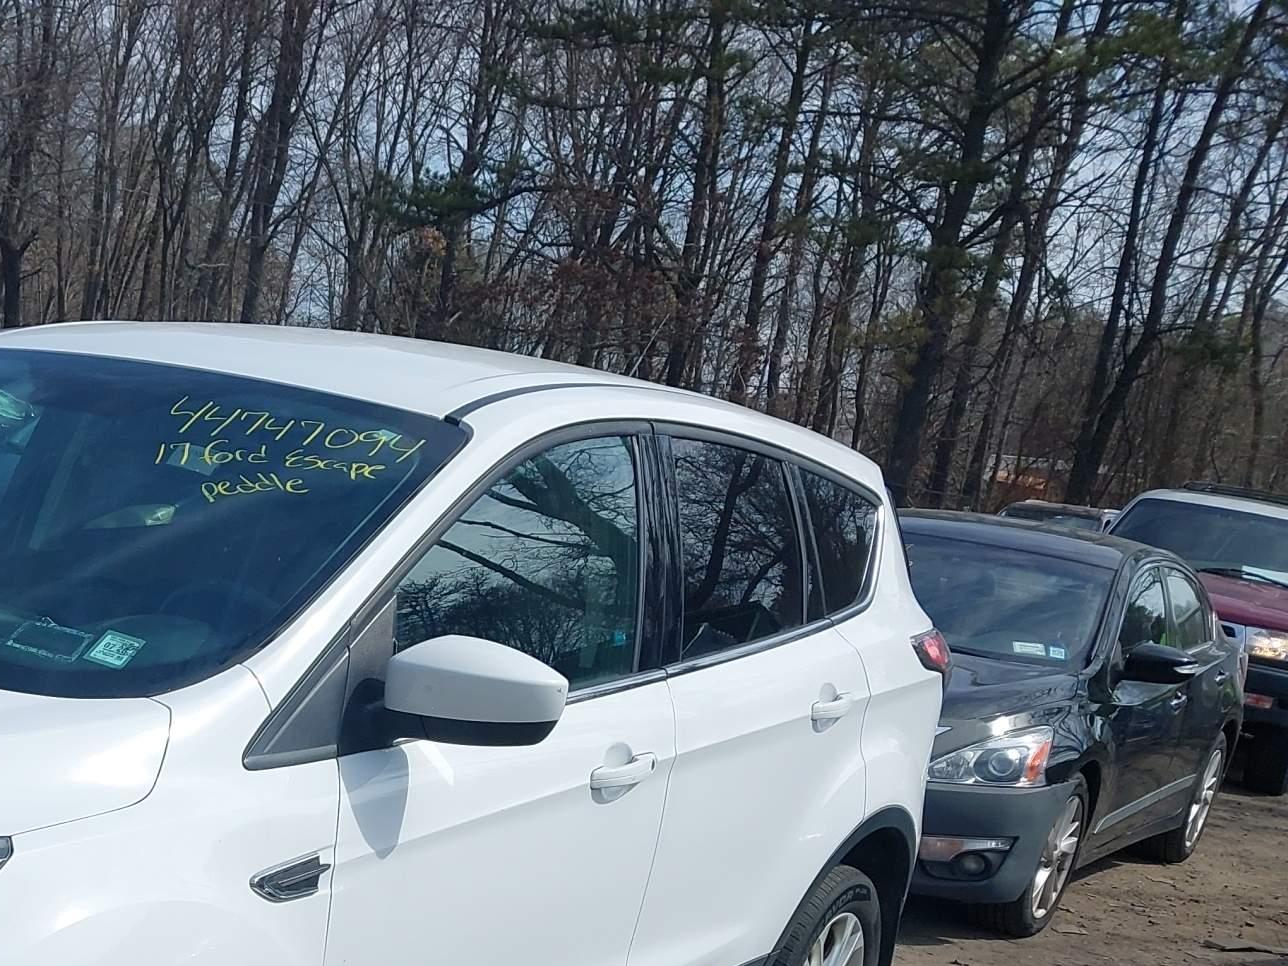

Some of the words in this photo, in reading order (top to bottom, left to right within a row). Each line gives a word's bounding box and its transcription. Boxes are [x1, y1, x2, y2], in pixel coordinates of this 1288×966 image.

[170, 395, 427, 463] 44747094
[155, 442, 191, 465] 17
[201, 472, 310, 503] peddle
